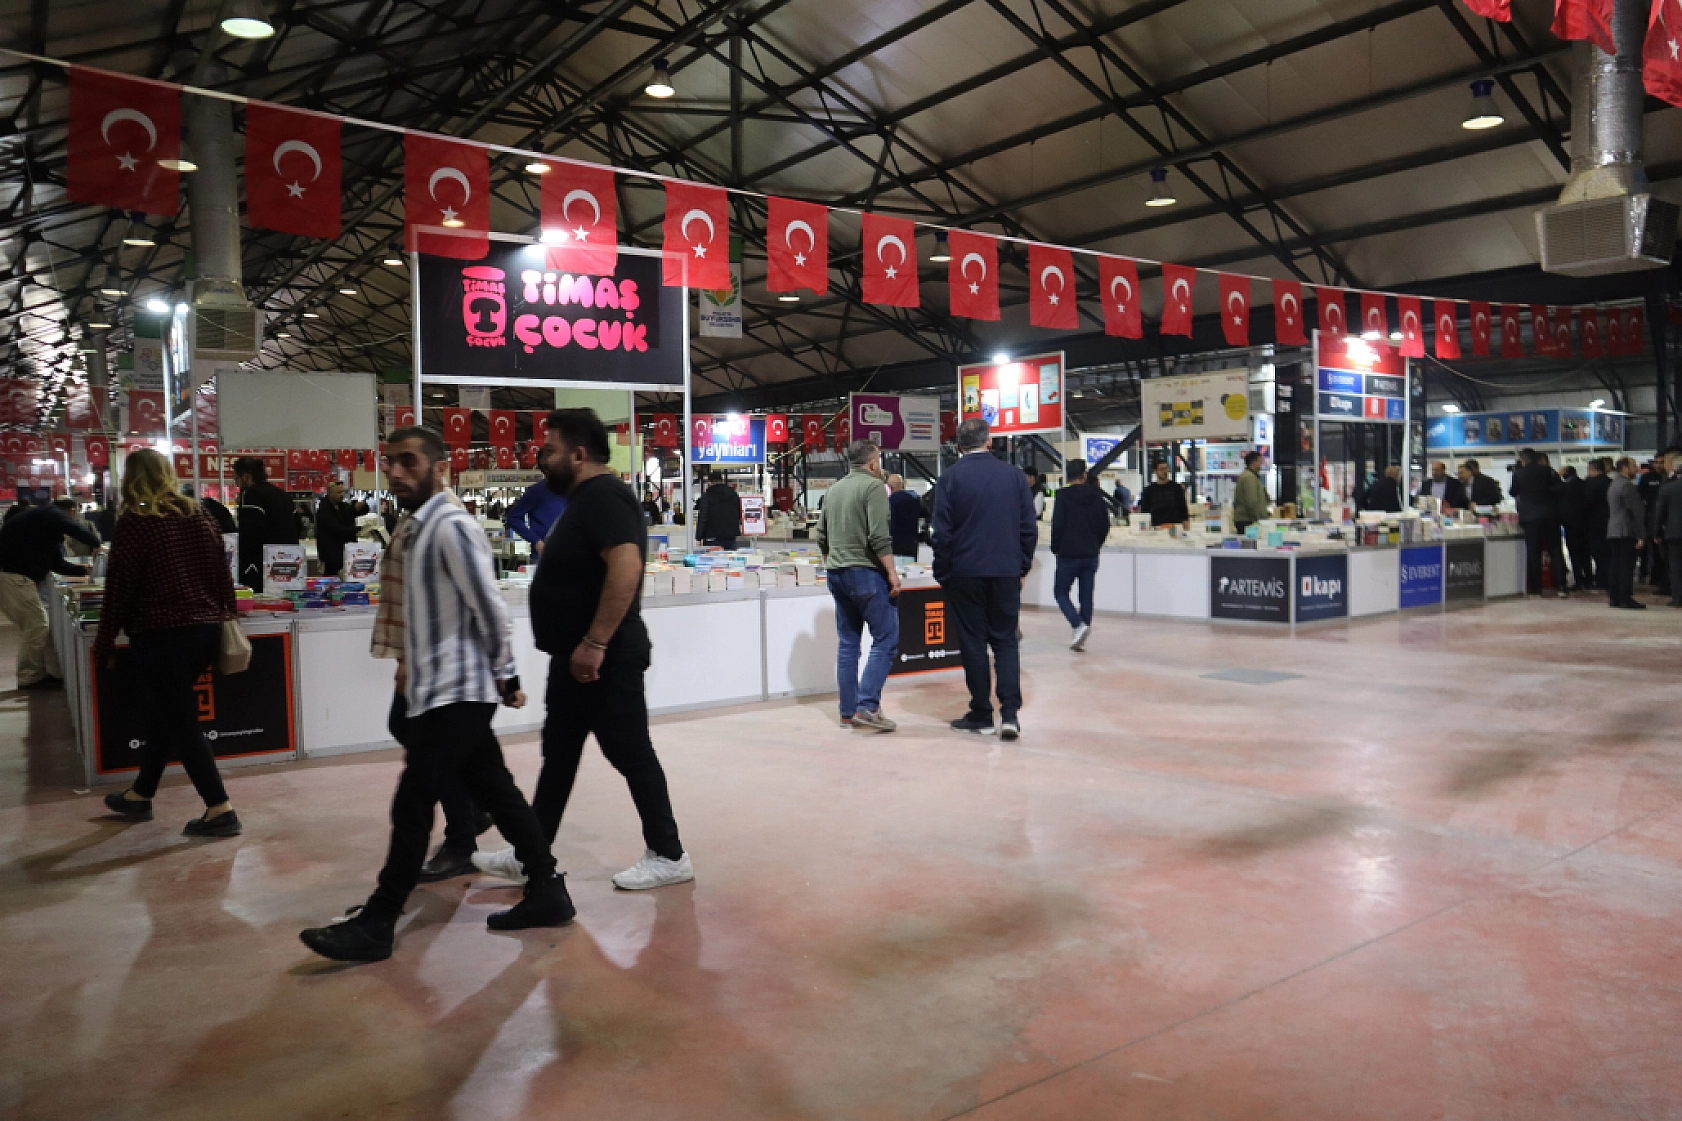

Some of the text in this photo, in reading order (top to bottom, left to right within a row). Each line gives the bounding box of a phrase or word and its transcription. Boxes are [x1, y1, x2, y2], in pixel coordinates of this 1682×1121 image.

[514, 314, 648, 354] ÇOCUK
[1229, 577, 1285, 598] ARTEMİS
[1314, 576, 1341, 600] kapı
